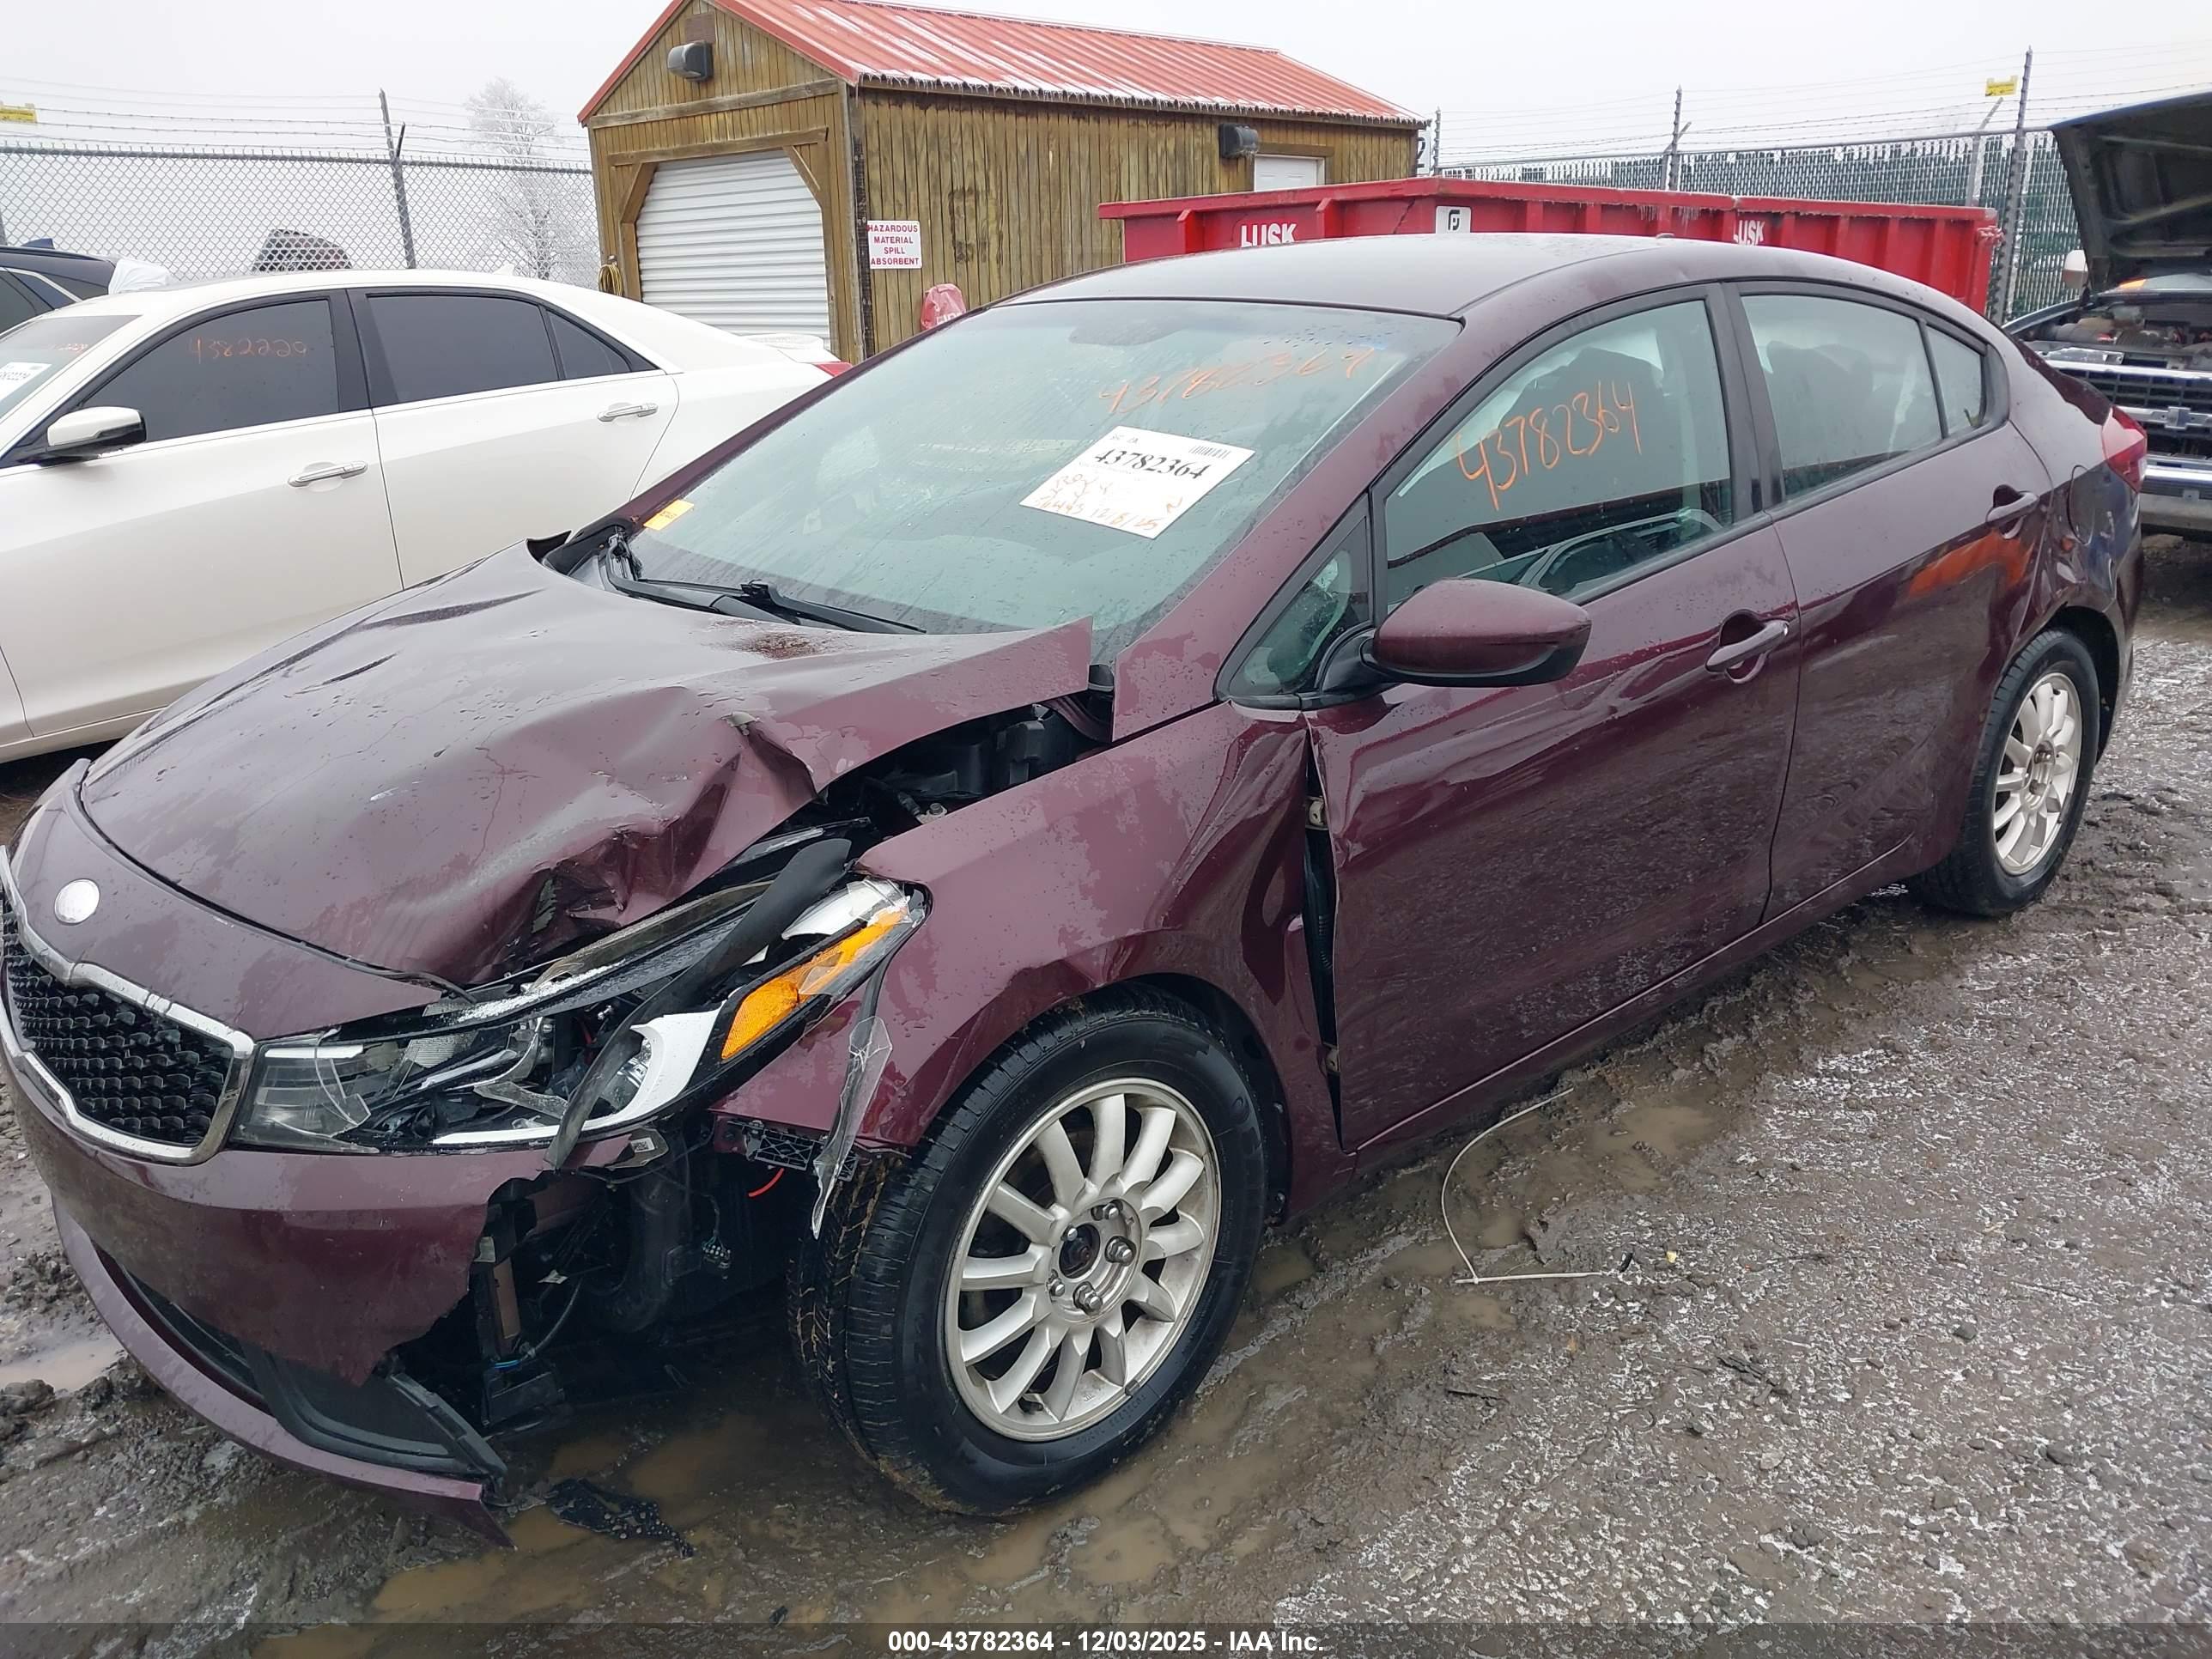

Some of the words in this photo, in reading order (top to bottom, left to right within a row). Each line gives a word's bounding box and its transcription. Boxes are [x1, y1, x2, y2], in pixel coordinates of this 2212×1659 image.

[866, 224, 918, 233] HAZARDOUS
[1241, 222, 1297, 247] LUSK
[884, 246, 906, 255] SPILL
[1455, 380, 1642, 512] 43782364
[1094, 448, 1212, 480] 43782364
